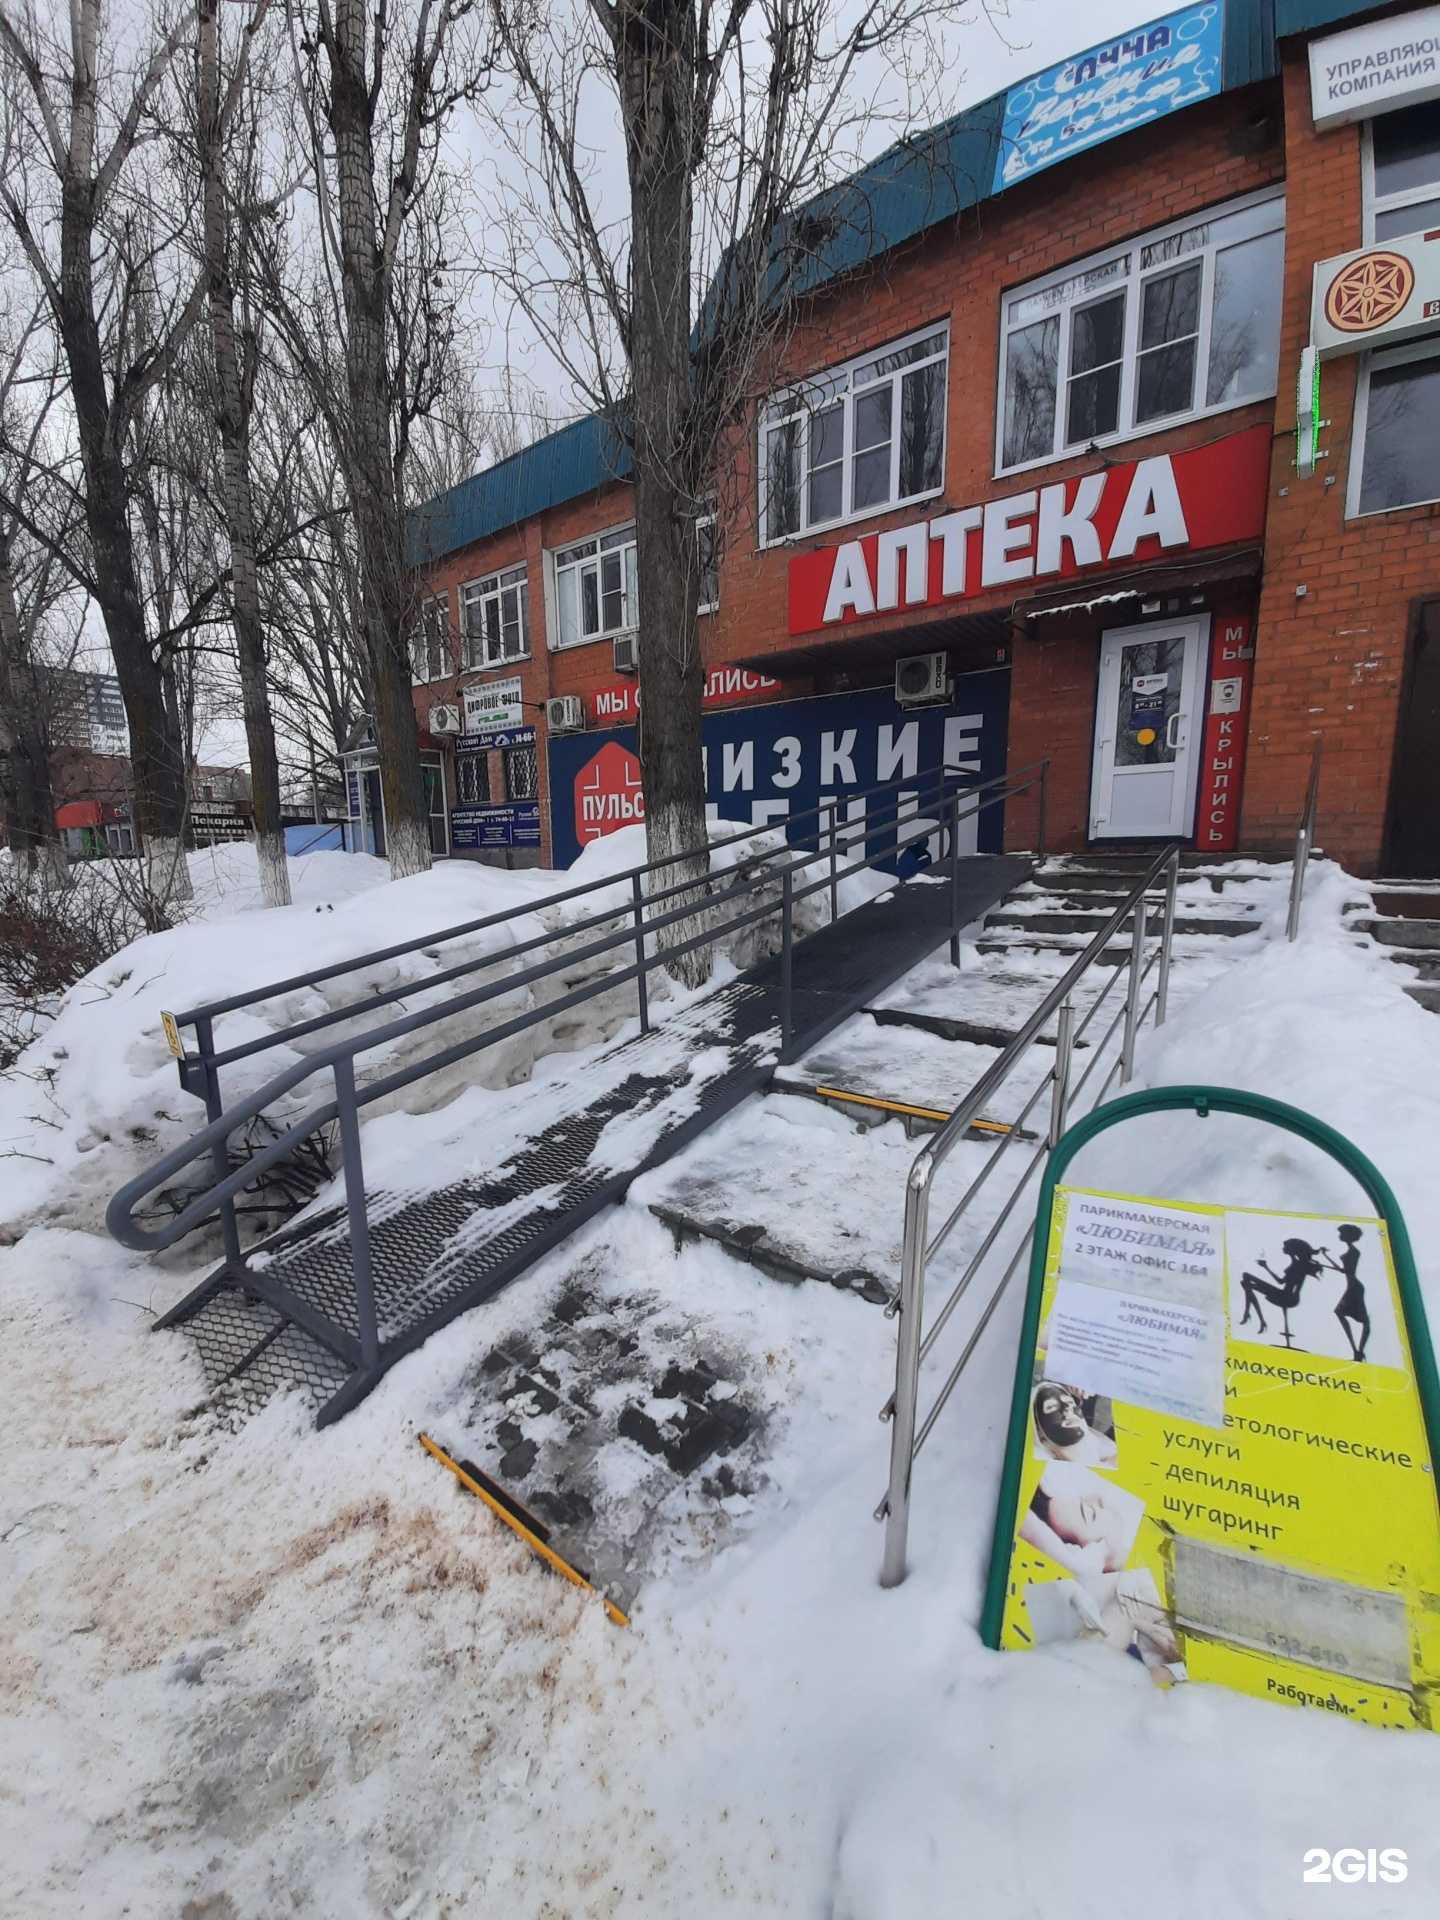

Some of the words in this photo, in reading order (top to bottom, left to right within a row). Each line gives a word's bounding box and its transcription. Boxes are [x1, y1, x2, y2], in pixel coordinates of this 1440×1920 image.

[1328, 57, 1436, 100] КОМПАНИЯ
[822, 453, 1190, 624] АПТЕКА
[596, 689, 629, 715] МЫ
[703, 713, 984, 793] ИЗКИЕ
[1208, 719, 1234, 841] КРЫЛИСЬ
[583, 791, 645, 821] ПУЛЬС
[1080, 1203, 1210, 1234] ПАРИКМАХЕРСКАЯ
[1076, 1222, 1215, 1257] «ЛЮБИМАЯ»
[1075, 1242, 1083, 1253] 2
[1087, 1245, 1127, 1262] ЭТАЖ
[1131, 1253, 1177, 1272] ОФИС
[1181, 1263, 1208, 1277] 164
[1120, 1300, 1209, 1327] ПАРИКМАХЕРСКАЯ
[1224, 1356, 1362, 1394] кмахерские
[1163, 1430, 1240, 1460] услуги
[1223, 1413, 1413, 1468] етологические
[1165, 1463, 1301, 1510] депиляция
[1163, 1495, 1284, 1540] шугаринг
